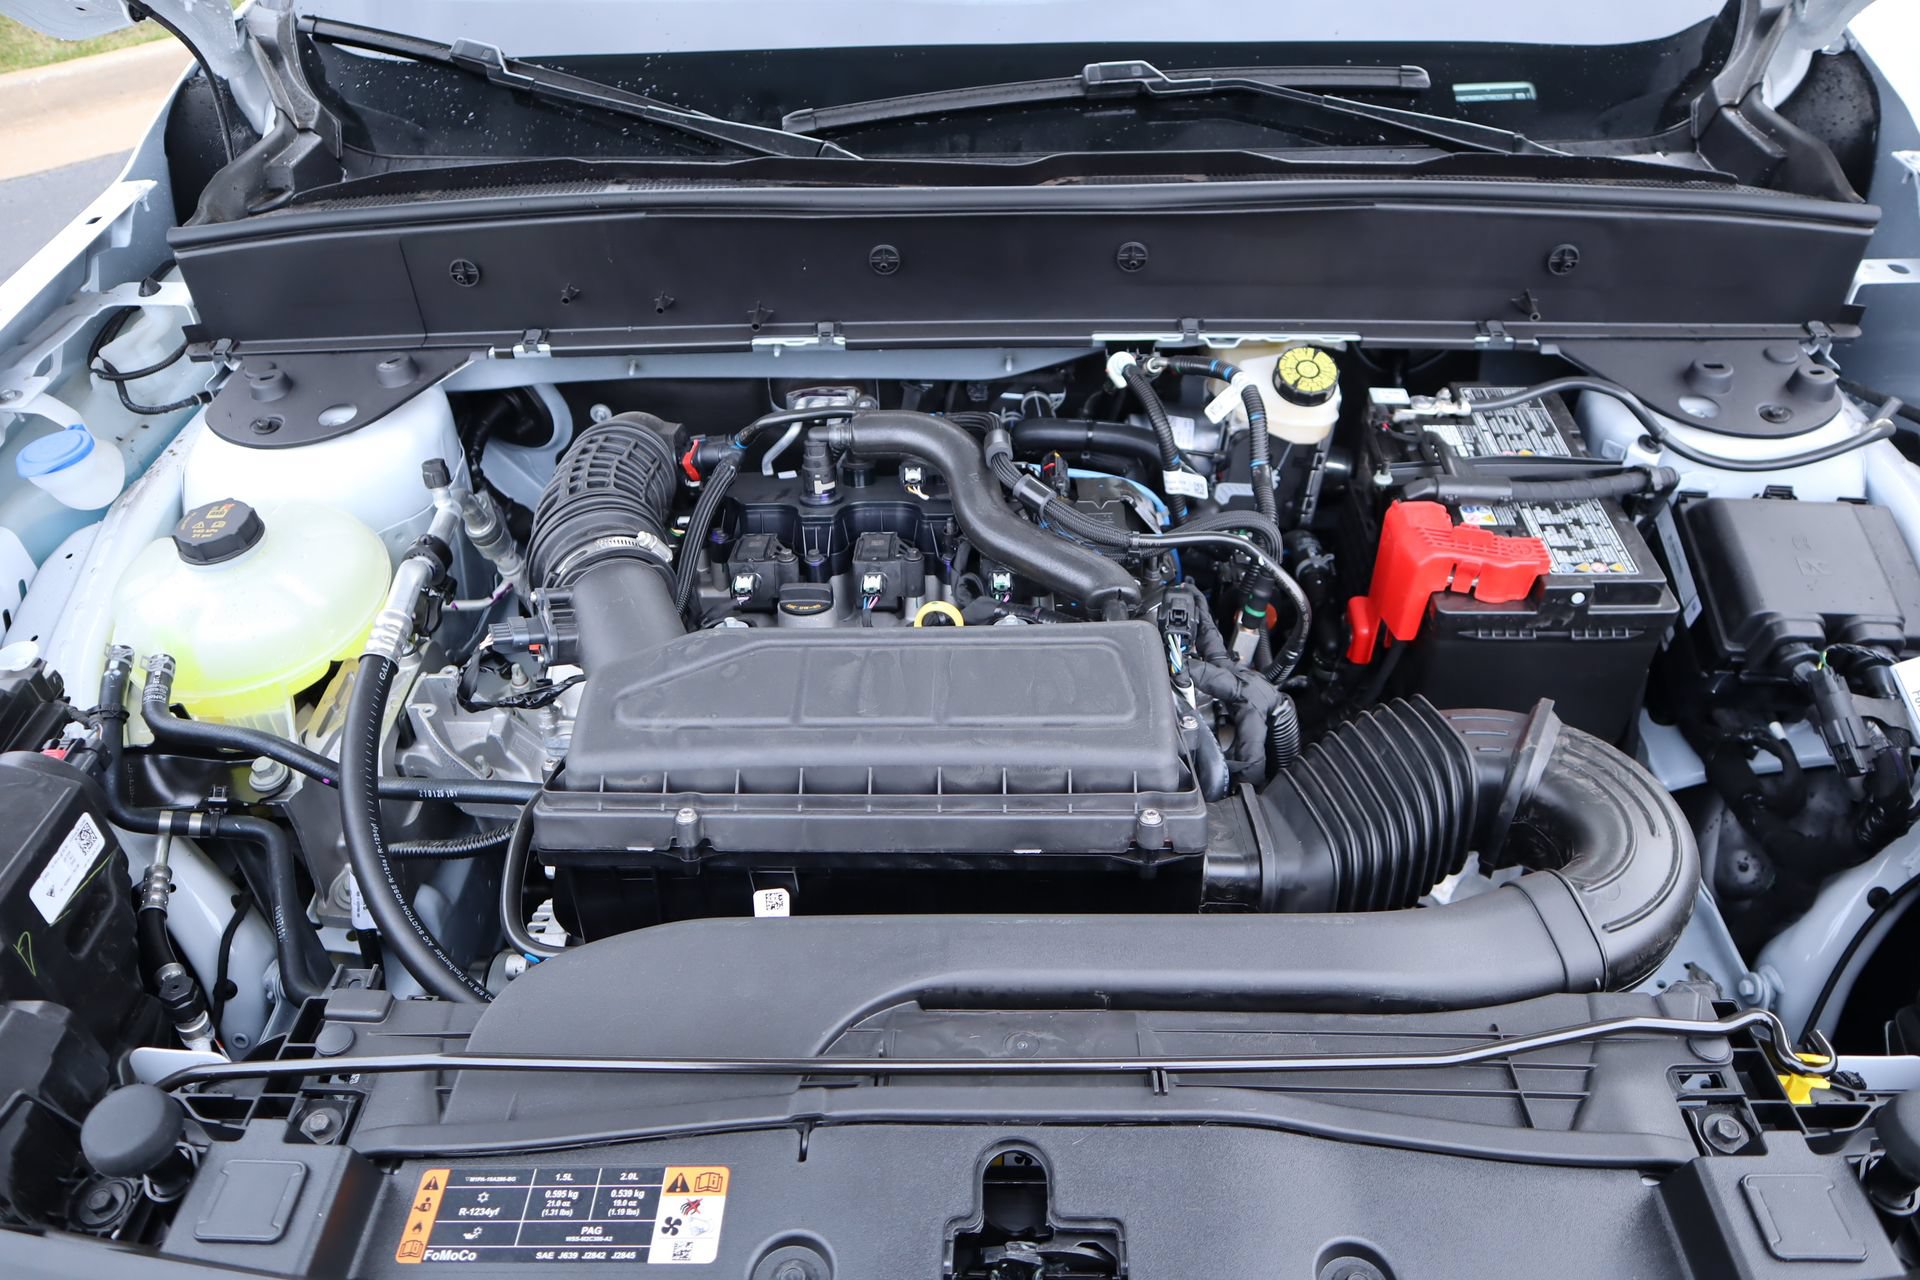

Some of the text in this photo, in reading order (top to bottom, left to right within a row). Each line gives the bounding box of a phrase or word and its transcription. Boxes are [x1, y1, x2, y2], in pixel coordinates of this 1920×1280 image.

[370, 822, 384, 854] R-1234yf
[382, 860, 395, 884] R-134a
[391, 884, 405, 905] HOSE
[402, 905, 425, 935] SUCTION
[422, 935, 435, 947] A/C
[434, 948, 468, 982] Flexbarrier
[555, 1173, 573, 1181] 1.5L
[619, 1172, 639, 1181] 2.0L
[544, 1190, 579, 1200] 0.595 kg
[610, 1189, 645, 1200] 0.539 kg
[458, 1207, 500, 1217] R-1234yf
[541, 1208, 573, 1217] (1.31 lbs)
[607, 1208, 640, 1217] (1.19 lbs)
[580, 1226, 603, 1235] PAG
[423, 1249, 477, 1261] FoMoCo
[535, 1251, 554, 1259] SAE
[557, 1251, 579, 1259] J639
